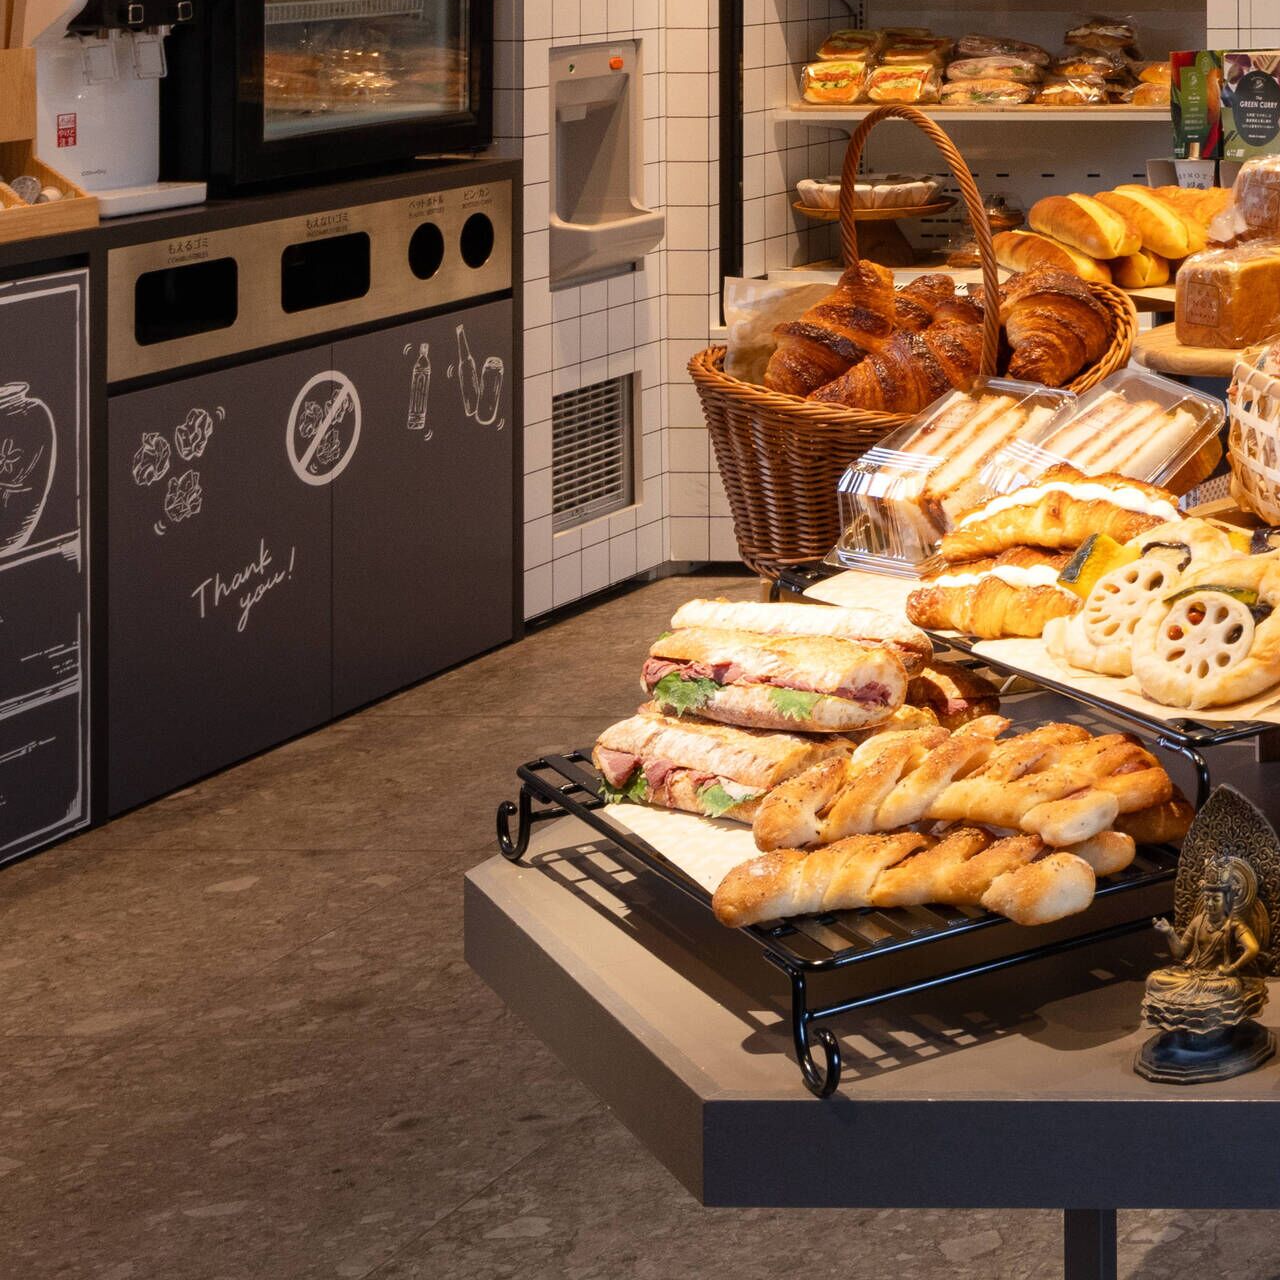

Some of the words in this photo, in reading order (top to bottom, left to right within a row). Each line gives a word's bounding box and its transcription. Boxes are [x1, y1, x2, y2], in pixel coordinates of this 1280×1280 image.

[168, 238, 209, 255] もえるゴミ
[191, 538, 272, 619] Thank
[237, 546, 296, 632] you!
